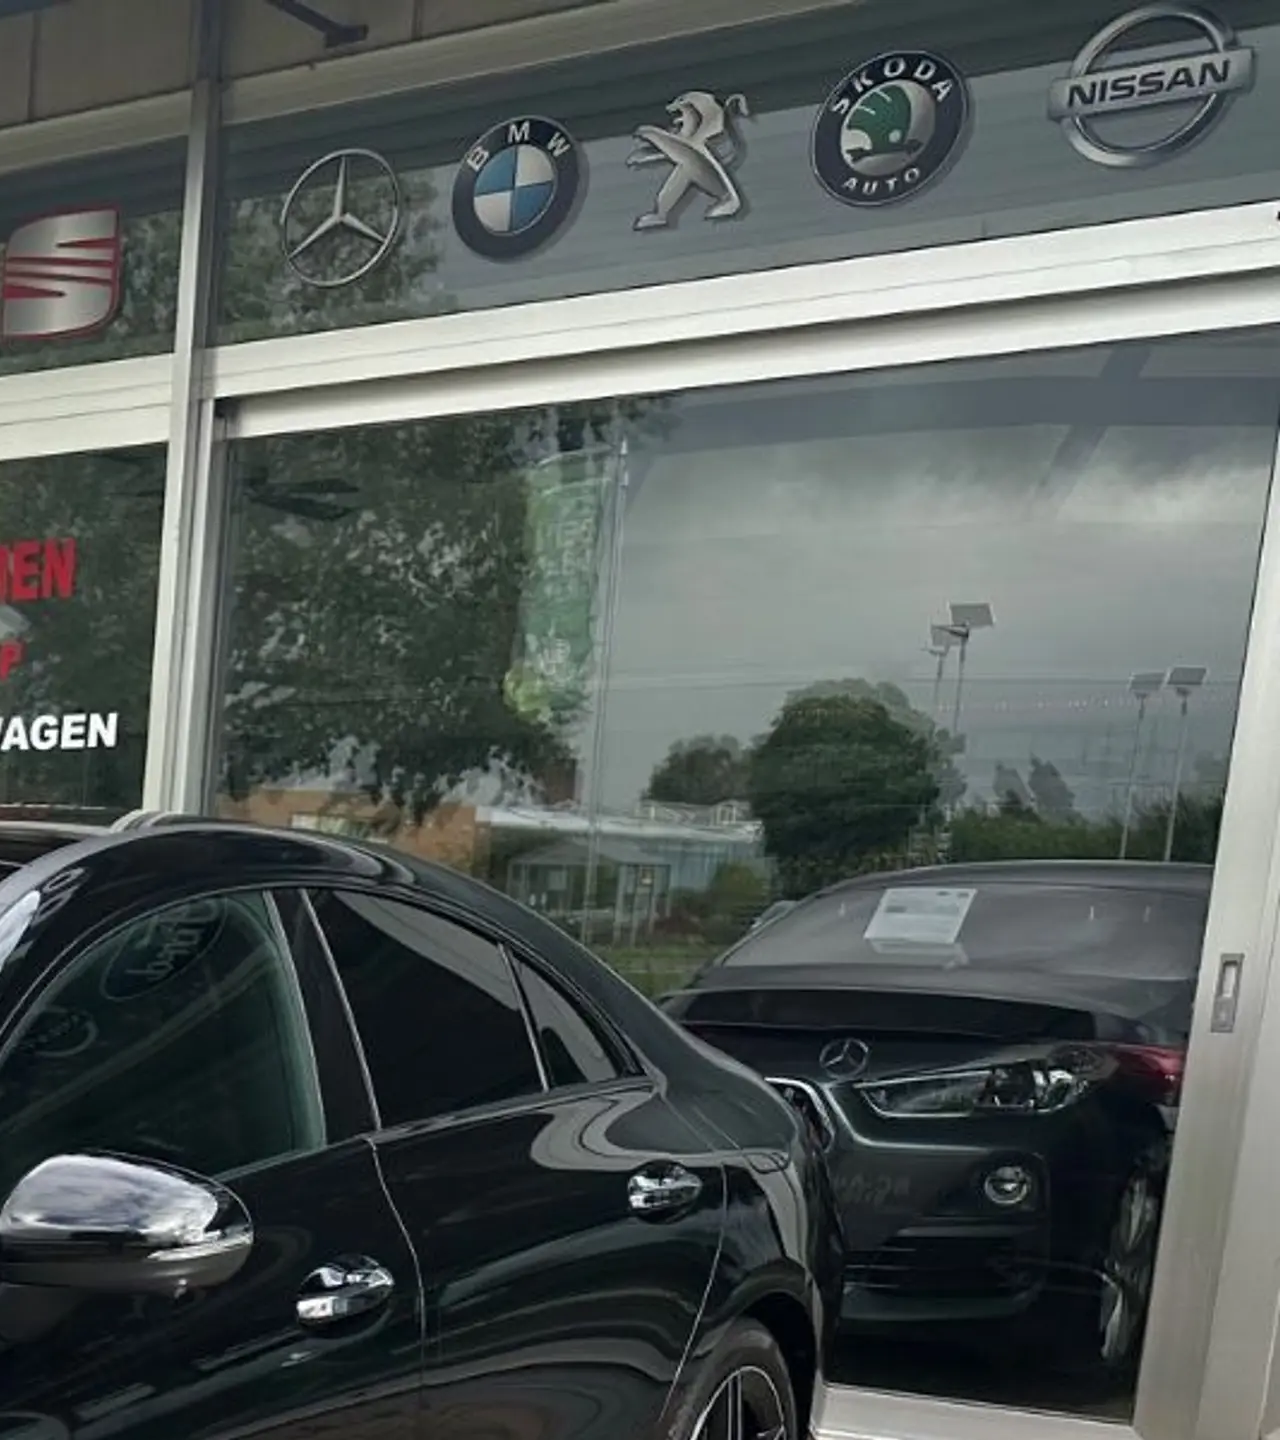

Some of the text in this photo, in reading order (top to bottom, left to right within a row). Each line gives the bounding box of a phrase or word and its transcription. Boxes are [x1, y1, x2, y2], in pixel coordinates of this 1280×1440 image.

[1068, 59, 1231, 108] NISSAN
[466, 120, 572, 172] BMW
[842, 168, 920, 195] AUTO
